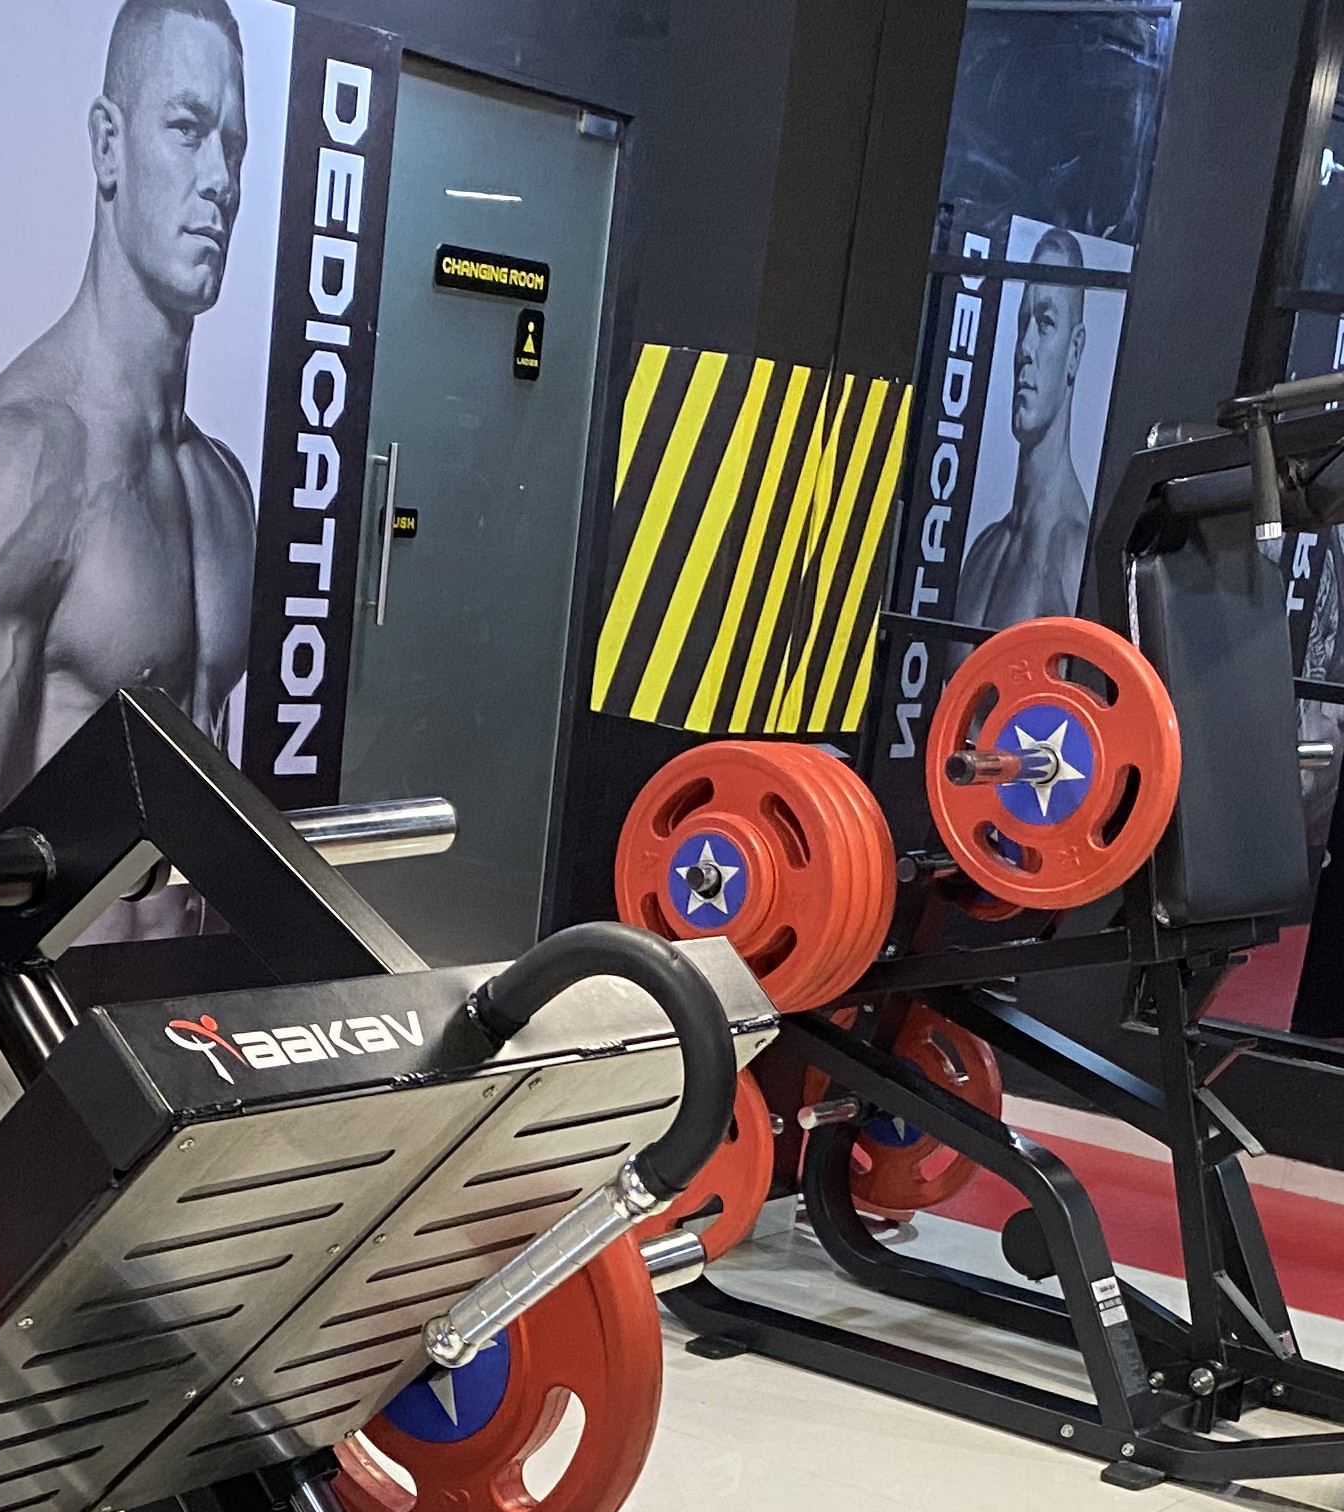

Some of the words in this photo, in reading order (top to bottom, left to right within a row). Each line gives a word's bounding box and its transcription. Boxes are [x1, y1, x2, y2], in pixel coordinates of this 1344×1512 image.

[442, 257, 508, 284] CHANGING
[509, 269, 545, 290] ROOM
[275, 59, 374, 777] DEDICATION
[392, 516, 416, 530] USH
